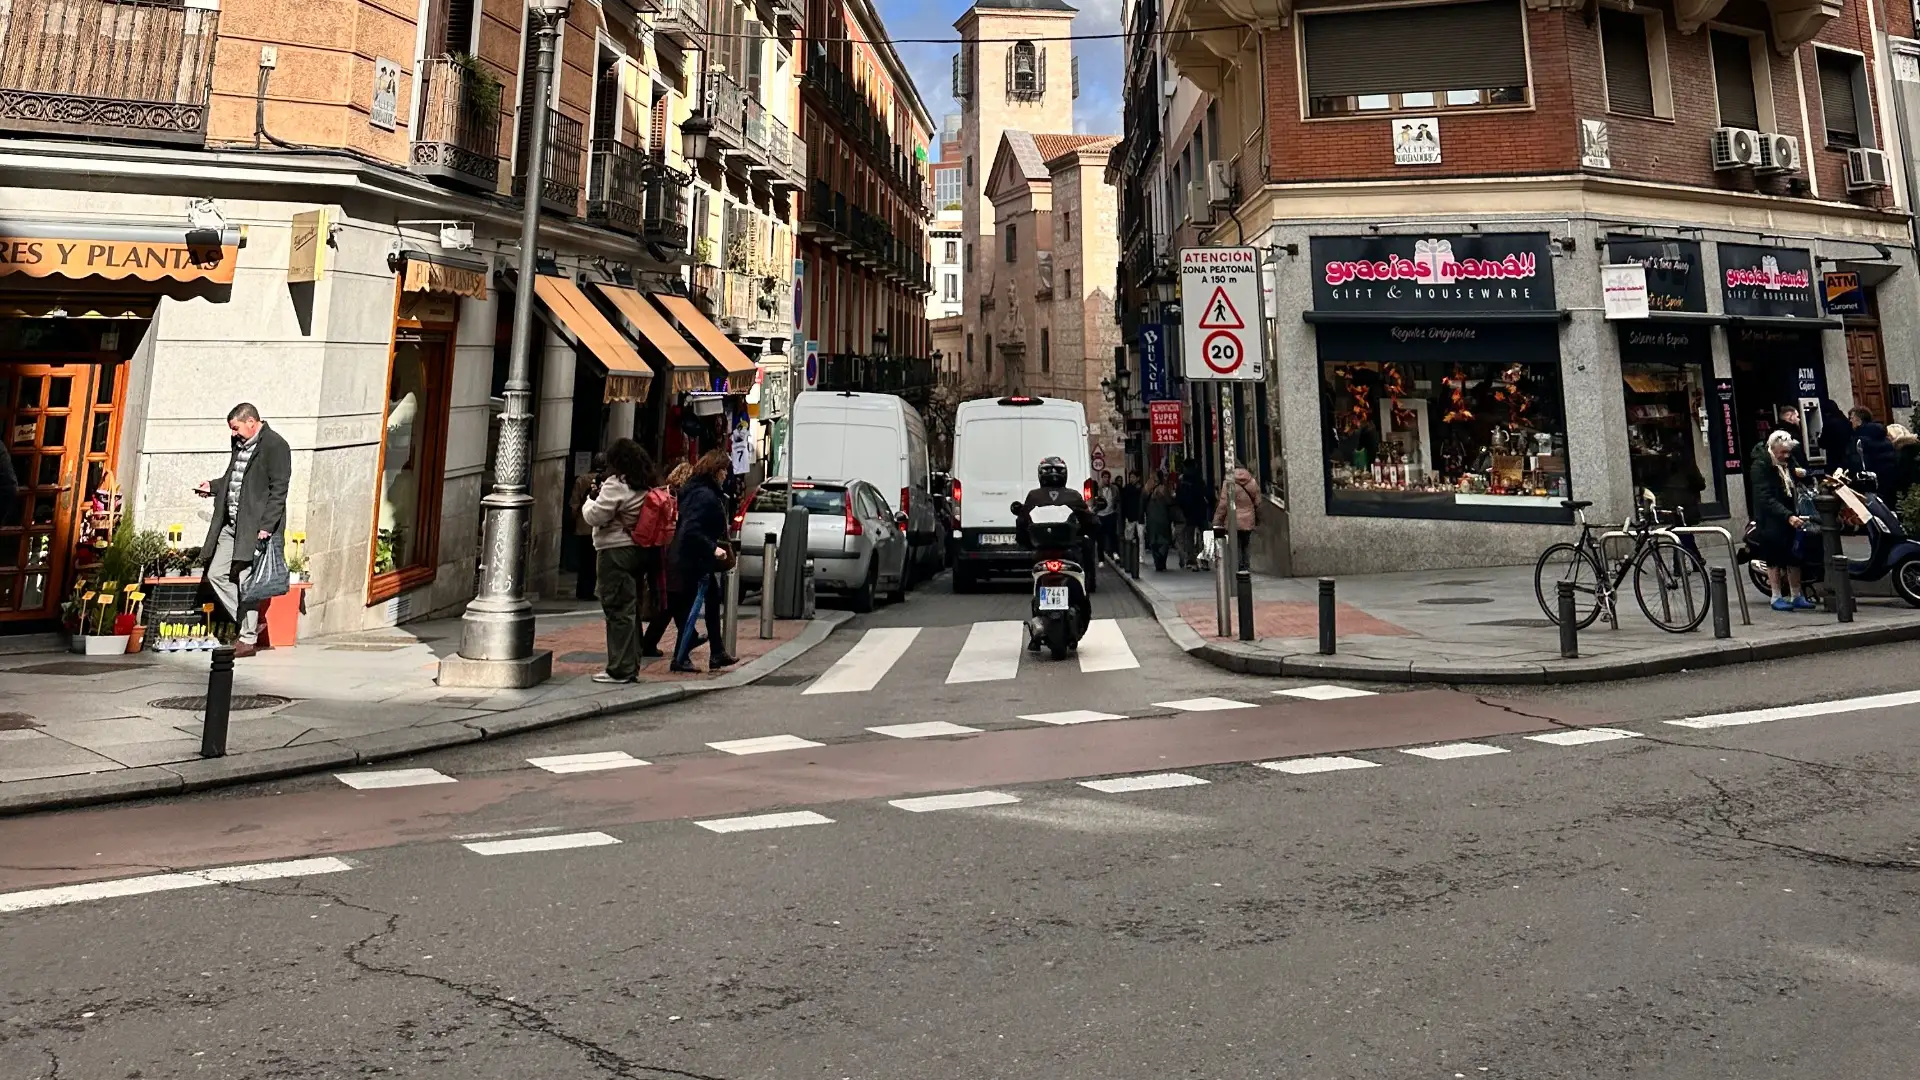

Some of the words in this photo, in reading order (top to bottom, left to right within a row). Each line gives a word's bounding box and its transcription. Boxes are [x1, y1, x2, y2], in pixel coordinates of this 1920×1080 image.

[57, 243, 77, 265] Y
[87, 244, 220, 271] PLANTAS
[1184, 250, 1253, 263] ATENCIÓN
[1182, 266, 1207, 274] ZONA
[1209, 265, 1255, 273] PEATONAL
[1325, 254, 1432, 286] gracias
[1440, 251, 1536, 281] mamá!!
[1211, 275, 1226, 283] 150
[1726, 266, 1771, 288] gracias
[1826, 275, 1857, 288] ATM
[1332, 289, 1372, 299] GIFT
[1386, 284, 1402, 299] &
[1415, 288, 1530, 299] HOUSEWARE
[1727, 290, 1747, 299] GIFT
[1763, 291, 1809, 302] HOUSEWARE
[1829, 302, 1859, 311] Euronet
[1211, 345, 1234, 359] 20
[1144, 330, 1159, 391] BRUNCH
[1798, 368, 1814, 379] ATM
[1799, 380, 1816, 391] Cajero
[1153, 413, 1179, 421] SUPER
[736, 450, 744, 463] 7
[1046, 588, 1065, 597] 7441
